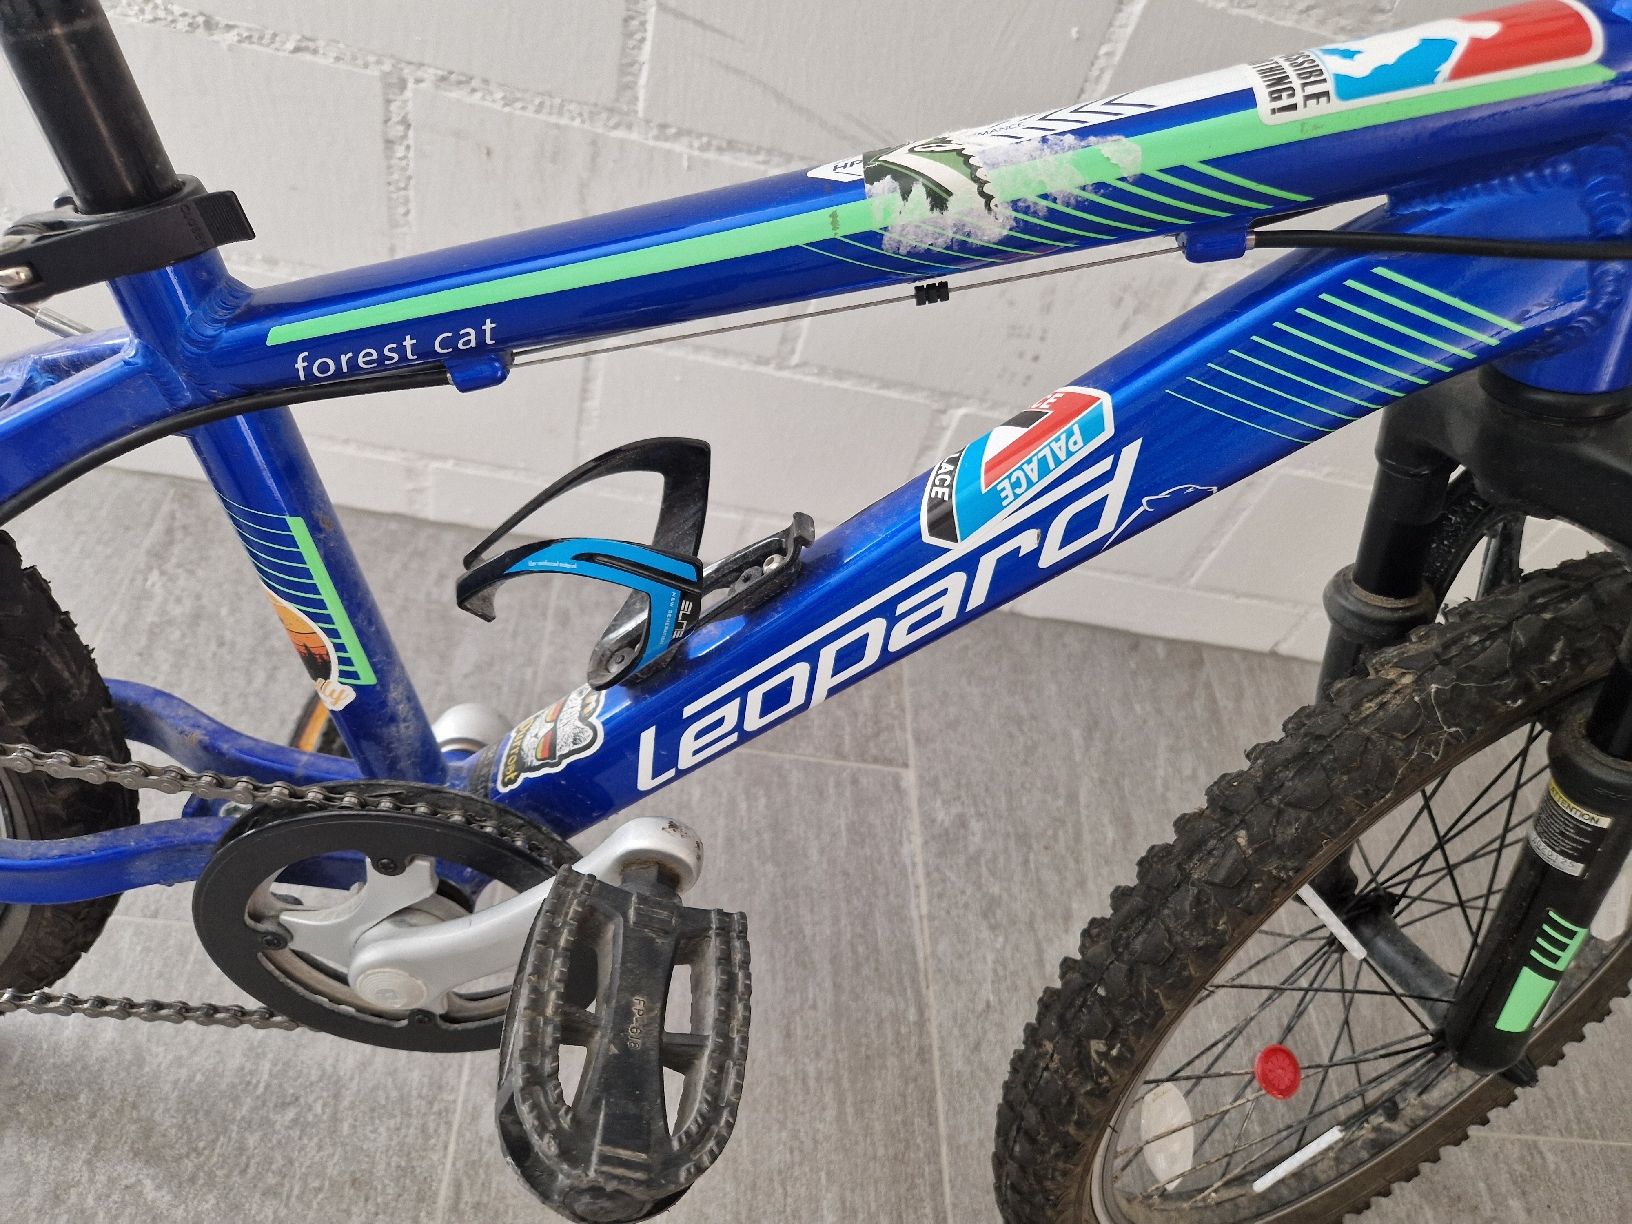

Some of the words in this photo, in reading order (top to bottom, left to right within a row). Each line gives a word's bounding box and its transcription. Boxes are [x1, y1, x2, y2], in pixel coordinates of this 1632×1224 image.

[1250, 59, 1298, 116] THING!
[1282, 51, 1331, 109] SSIBLE
[294, 333, 418, 382] forest
[433, 317, 498, 355] cat
[996, 422, 1085, 508] PALACE
[635, 436, 1144, 792] Leopard
[1550, 786, 1601, 825] ATTENTION
